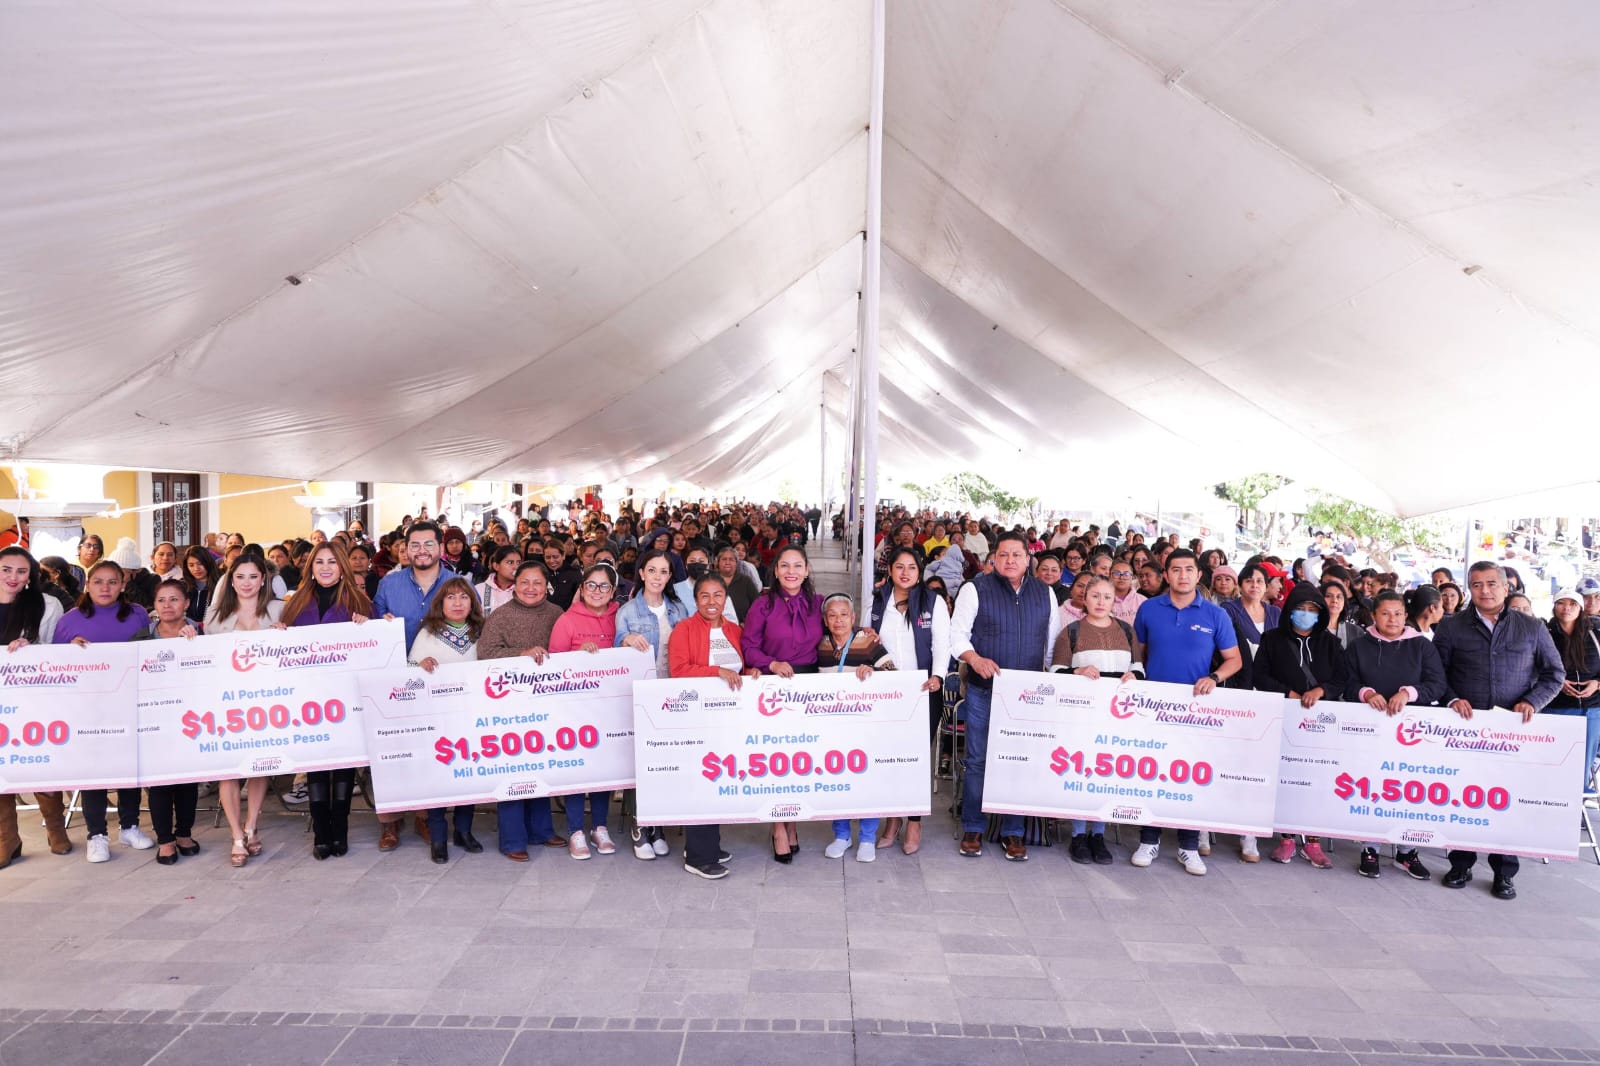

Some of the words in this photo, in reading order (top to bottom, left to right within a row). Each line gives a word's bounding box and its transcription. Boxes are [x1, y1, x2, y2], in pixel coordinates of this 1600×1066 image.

[258, 642, 309, 659] Mujeres
[310, 638, 378, 654] Construyendo
[0, 661, 38, 676] ujeres
[39, 661, 110, 673] Construyendo
[278, 652, 348, 668] Resultados
[3, 673, 78, 686] Resultados
[511, 671, 562, 686] Mujeres
[563, 665, 630, 679] Construyendo
[222, 690, 235, 701] Al
[238, 686, 295, 701] Portador
[532, 679, 600, 695] Resultados
[785, 689, 835, 704] Mujeres
[836, 689, 903, 702] Construyendo
[804, 701, 873, 714] Resultados
[1137, 697, 1188, 712] Mujeres
[1188, 701, 1256, 719] Construyendo
[181, 698, 346, 740] $1,500.00
[475, 717, 489, 728] Al
[492, 712, 550, 726] Portador
[1155, 710, 1225, 727] Resultados
[745, 734, 758, 745] Al
[762, 733, 820, 745] Portador
[1094, 734, 1108, 745] Al
[1111, 735, 1168, 750] Portador
[1424, 723, 1480, 739] Mujeres
[1480, 727, 1556, 744] Construyendo
[199, 741, 218, 753] Mil
[222, 733, 290, 752] Quinientos
[293, 732, 331, 745] Pesos
[434, 724, 600, 766] $1,500.00
[1444, 736, 1520, 753] Resultados
[10, 754, 51, 765] Pesos
[701, 749, 868, 782] $1,500.00
[1049, 746, 1213, 786] $1,500.00
[453, 766, 473, 779] Mil
[477, 759, 545, 777] Quinientos
[548, 758, 585, 769] Pesos
[1380, 761, 1395, 772] Al
[1398, 762, 1460, 776] Portador
[718, 784, 738, 796] Mil
[742, 783, 811, 796] Quinientos
[814, 782, 851, 793] Pesos
[1063, 780, 1083, 792] Mil
[1086, 782, 1153, 798] Quinientos
[1157, 789, 1194, 802] Pesos
[1334, 771, 1511, 812] $1,500.00
[1349, 805, 1370, 816] Mil
[1373, 807, 1446, 823] Quinientos
[1449, 814, 1490, 827] Pesos
